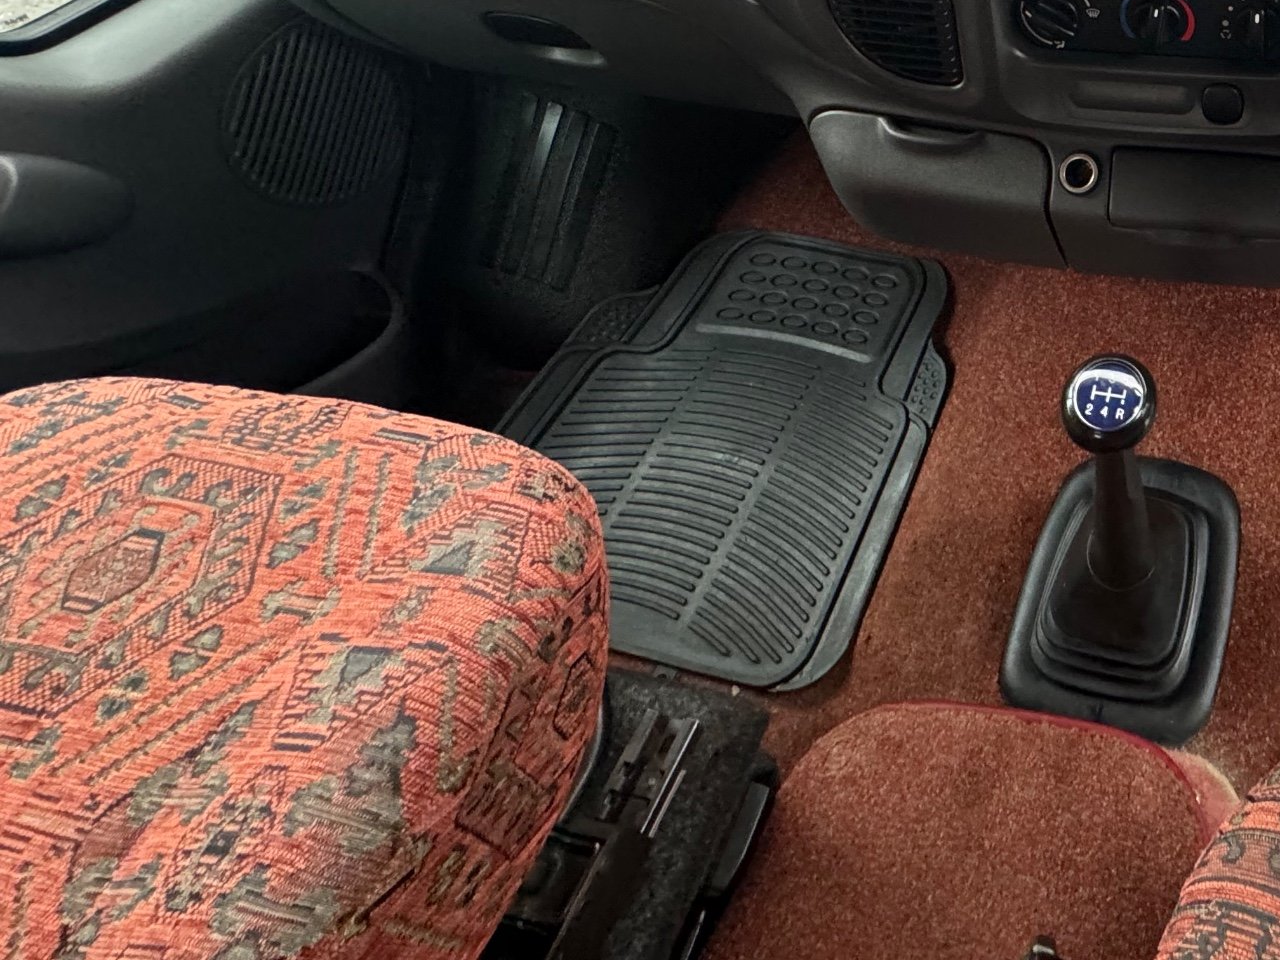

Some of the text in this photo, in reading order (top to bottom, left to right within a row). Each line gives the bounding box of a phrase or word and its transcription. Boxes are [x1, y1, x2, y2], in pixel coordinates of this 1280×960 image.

[1084, 403, 1125, 420] 2 4 R
